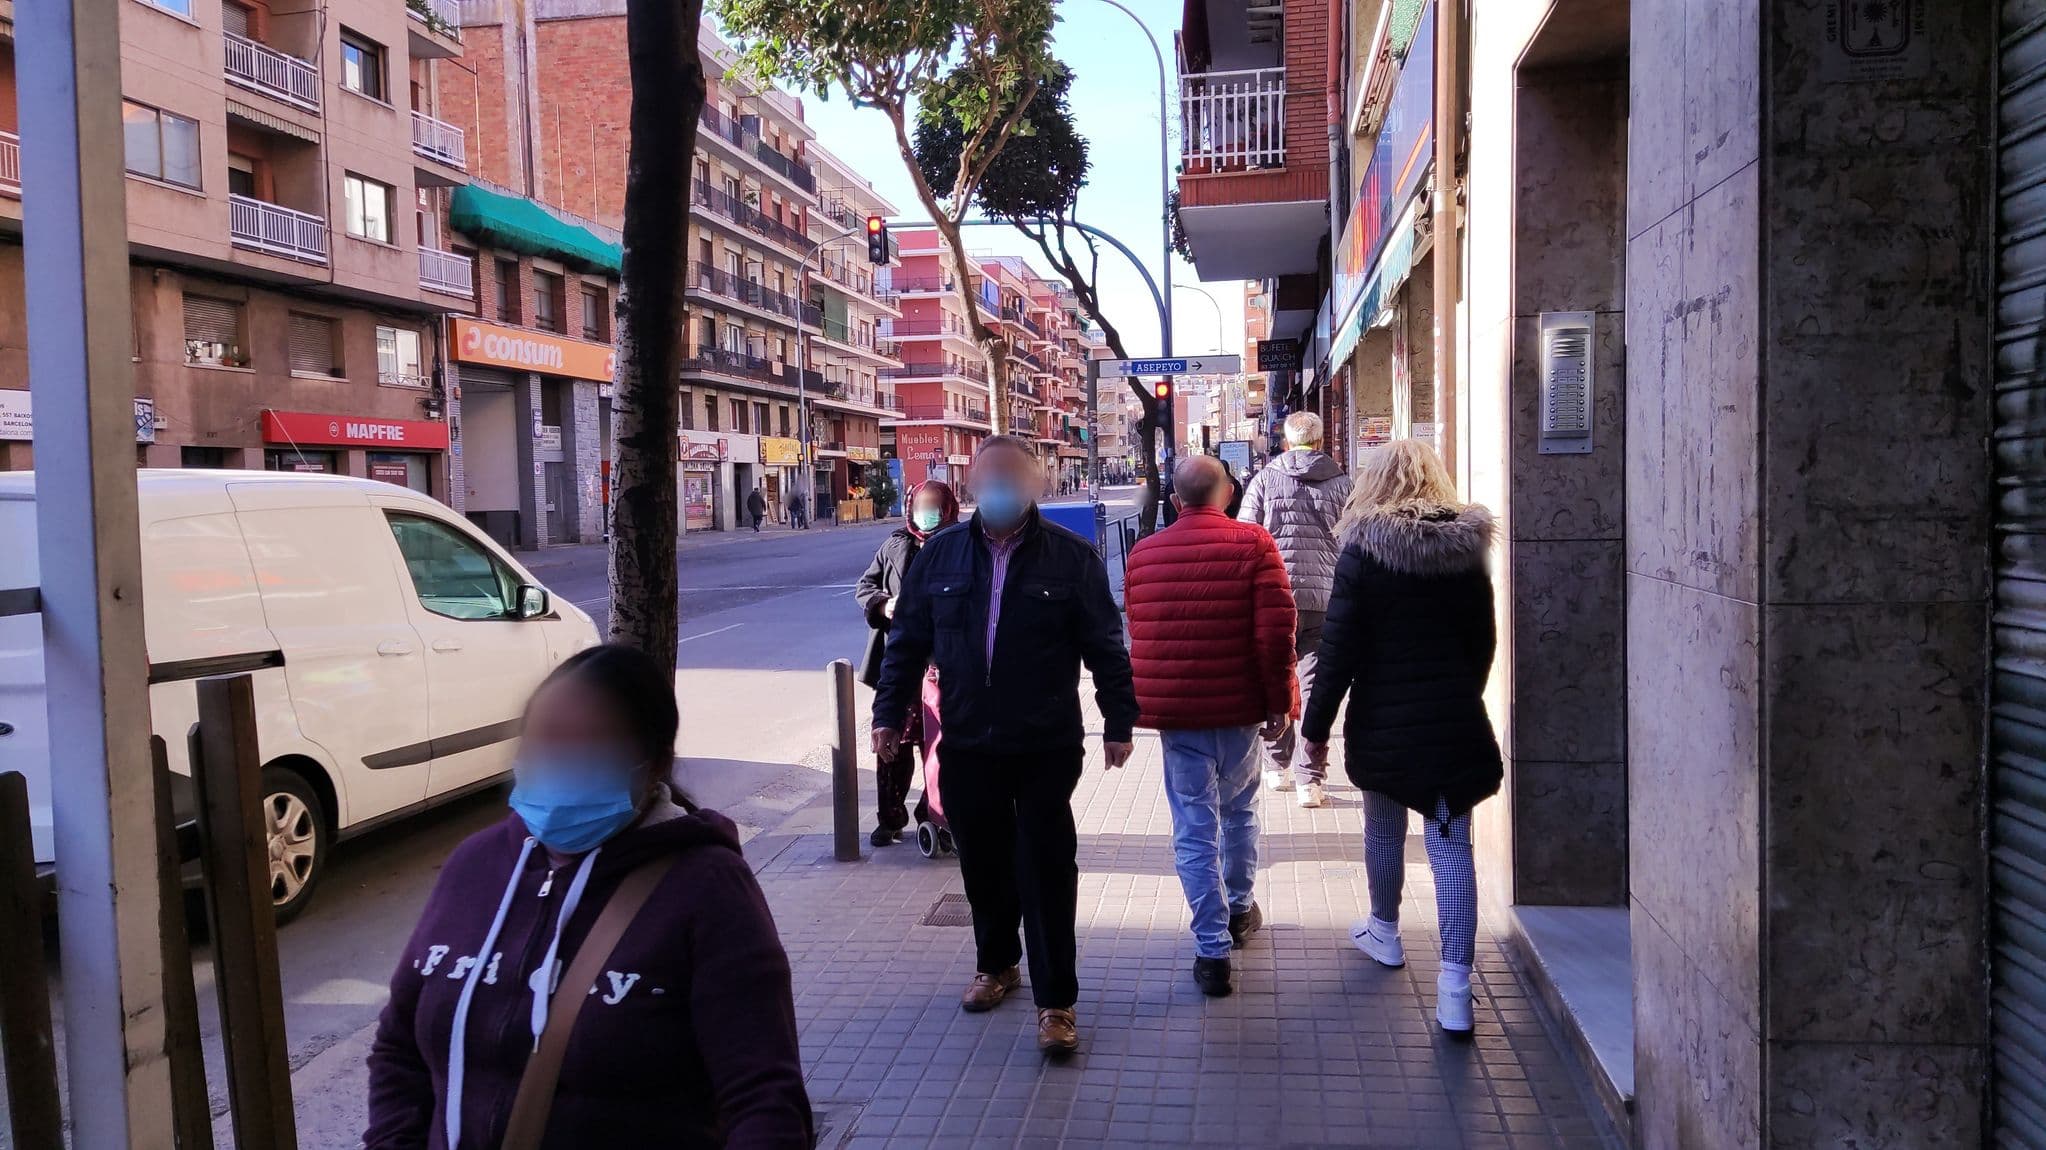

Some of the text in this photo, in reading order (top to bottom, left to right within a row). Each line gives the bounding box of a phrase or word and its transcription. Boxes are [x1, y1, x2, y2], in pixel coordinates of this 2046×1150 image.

[484, 333, 564, 369] consum
[1136, 362, 1182, 372] ASEPEYO
[346, 422, 404, 441] MAPFRE
[901, 433, 940, 445] Muebles
